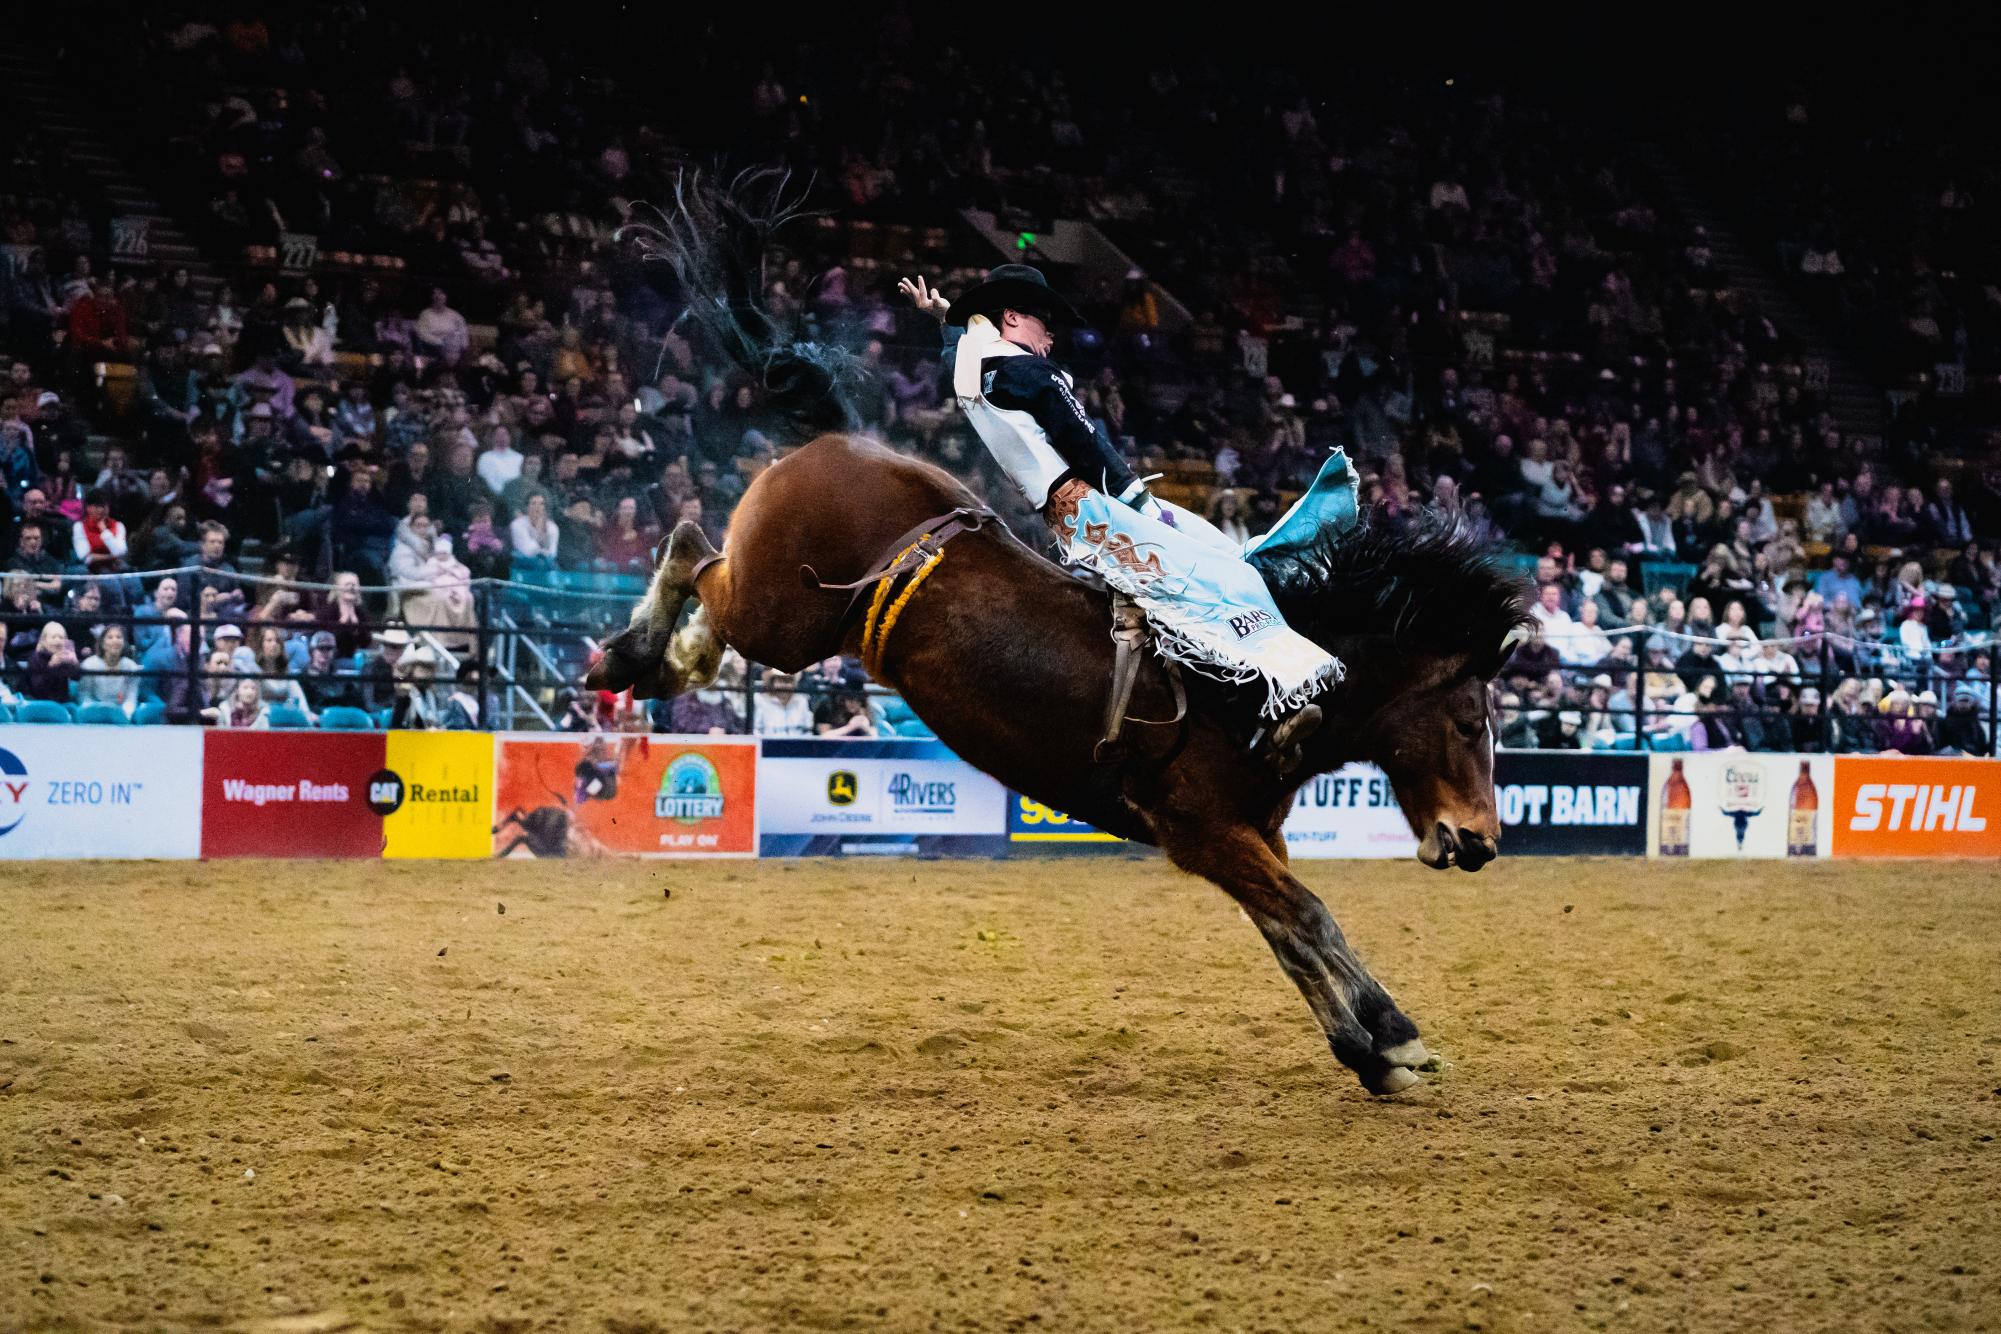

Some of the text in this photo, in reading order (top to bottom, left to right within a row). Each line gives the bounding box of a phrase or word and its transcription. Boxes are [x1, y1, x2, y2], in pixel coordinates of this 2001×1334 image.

[282, 242, 317, 268] 227
[0, 781, 29, 803] Y
[48, 781, 103, 804] ZERO
[223, 779, 349, 806] Wagner Rents
[369, 781, 400, 803] CAT
[410, 784, 479, 803] Rental
[655, 797, 724, 818] LOTTERY
[1551, 785, 1641, 825] BARN
[1850, 784, 1988, 832] STIHL
